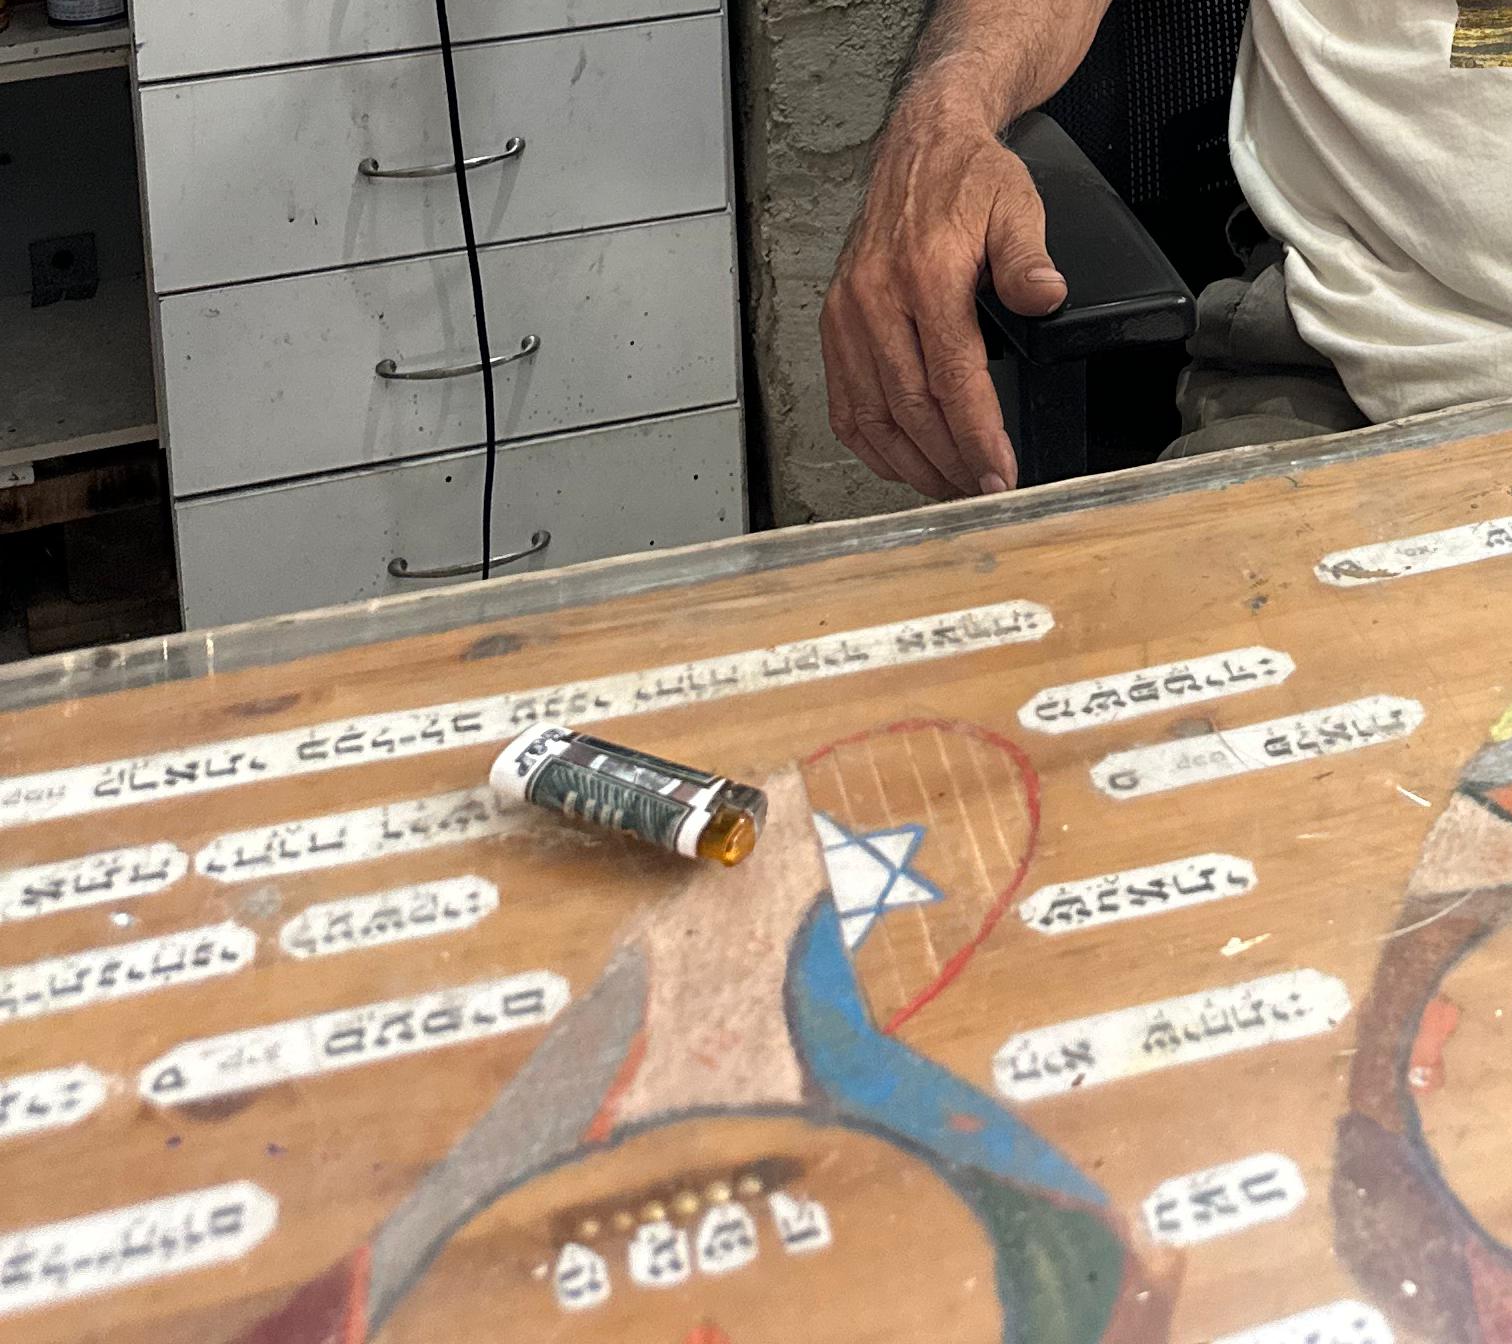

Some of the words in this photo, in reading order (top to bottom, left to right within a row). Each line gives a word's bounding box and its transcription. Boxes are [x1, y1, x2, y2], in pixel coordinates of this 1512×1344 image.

[92, 754, 267, 800] קראתי
[633, 663, 742, 704] יהוה
[1263, 708, 1405, 760] פלאות
[20, 859, 174, 907] אתה
[204, 828, 347, 874] יהוה
[1037, 861, 1252, 927] שנאתי
[322, 986, 549, 1057] סעפים
[1006, 1033, 1096, 1082] היא
